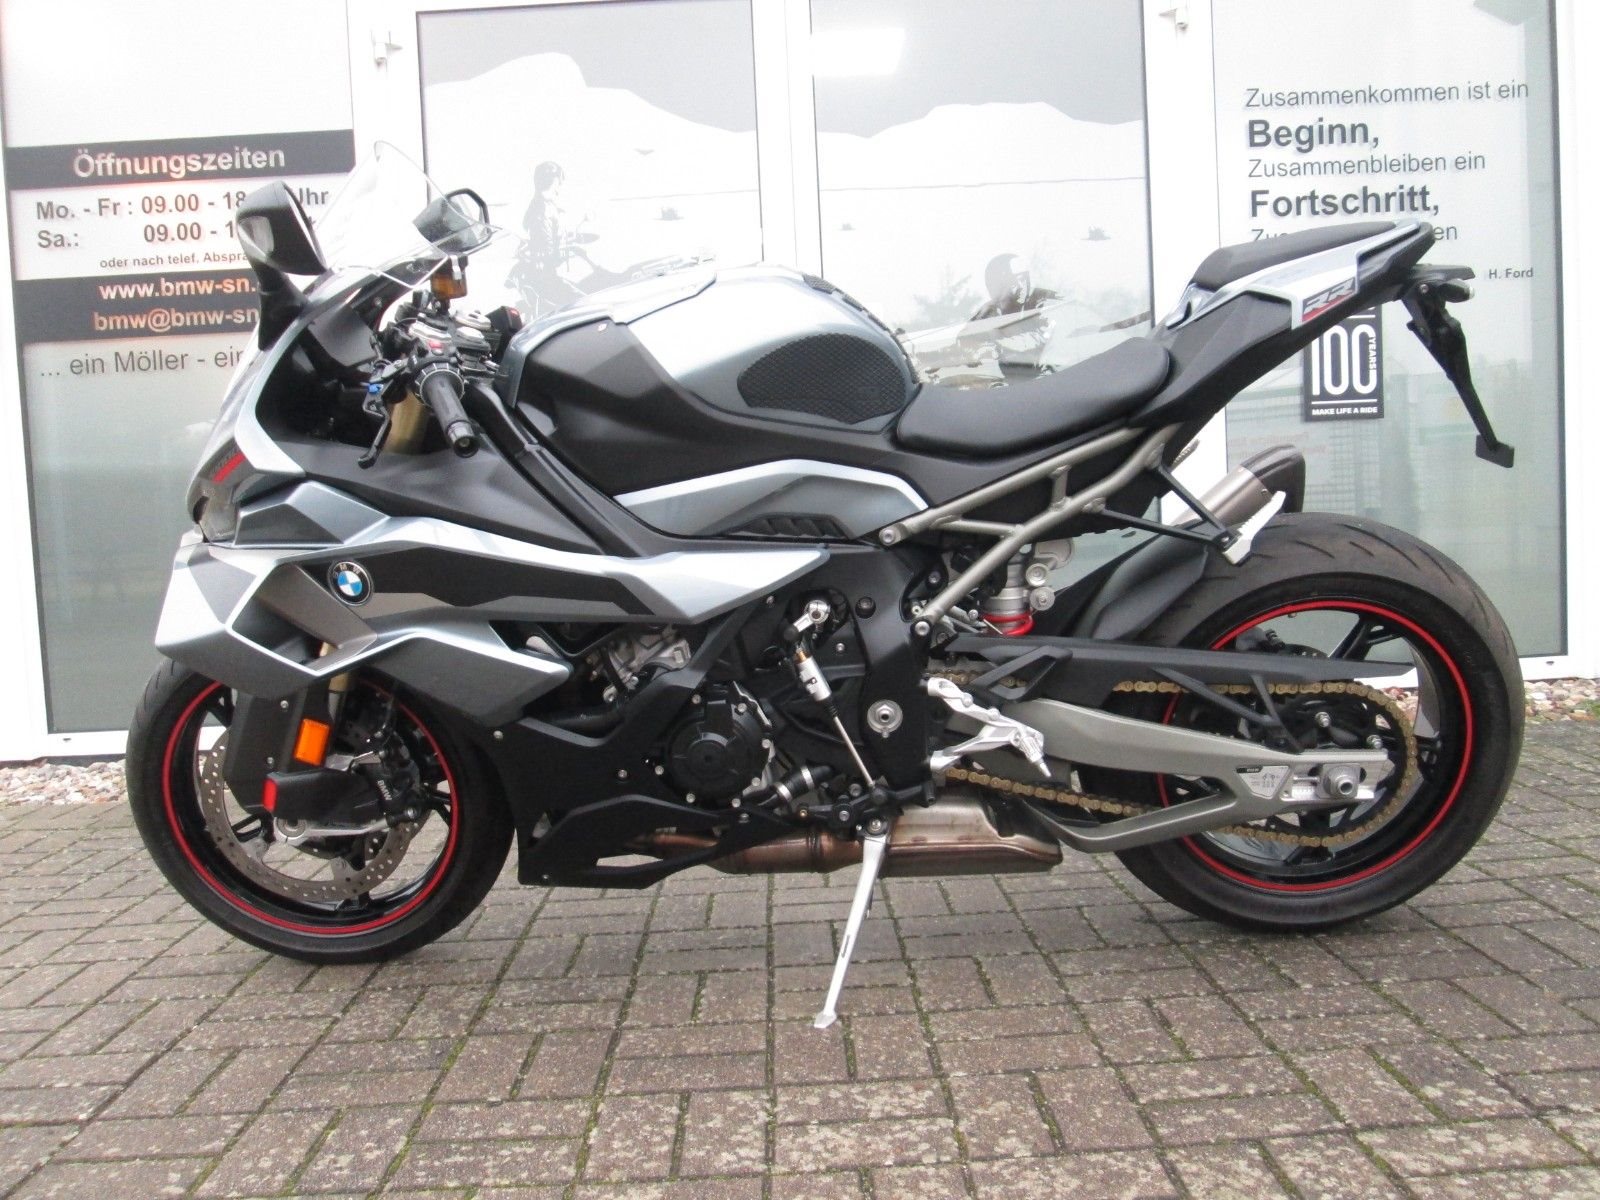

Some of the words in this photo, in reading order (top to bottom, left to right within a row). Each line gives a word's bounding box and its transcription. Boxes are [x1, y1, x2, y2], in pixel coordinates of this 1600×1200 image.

[1245, 85, 1459, 108] Zusammenkommen
[1468, 82, 1490, 99] ist
[1498, 80, 1529, 98] ein
[1248, 117, 1379, 153] Beginn,
[73, 147, 286, 179] Öffnungszeiten
[1248, 154, 1446, 178] Zusammenbleiben
[1454, 151, 1486, 170] ein
[36, 201, 76, 220] Mo.
[141, 193, 200, 214] 09.00
[223, 191, 247, 210] 18
[1251, 184, 1439, 217] Fortschritt,
[37, 229, 79, 249] Sa.:
[143, 222, 202, 243] 09.00
[99, 257, 129, 268] oder
[133, 255, 164, 267] nach
[203, 251, 249, 264] Abspra
[1488, 269, 1502, 280] H.
[1505, 268, 1534, 279] Ford
[98, 277, 256, 300] www.bmw-sn.
[93, 307, 259, 333] bmw@bmw-sn
[69, 353, 105, 375] ein
[115, 349, 189, 373] Möller
[1311, 323, 1378, 396] 100
[1368, 337, 1377, 370] YEARS
[1311, 408, 1335, 416] MAKE
[1336, 407, 1353, 415] LIFE
[1360, 406, 1378, 414] RIDE
